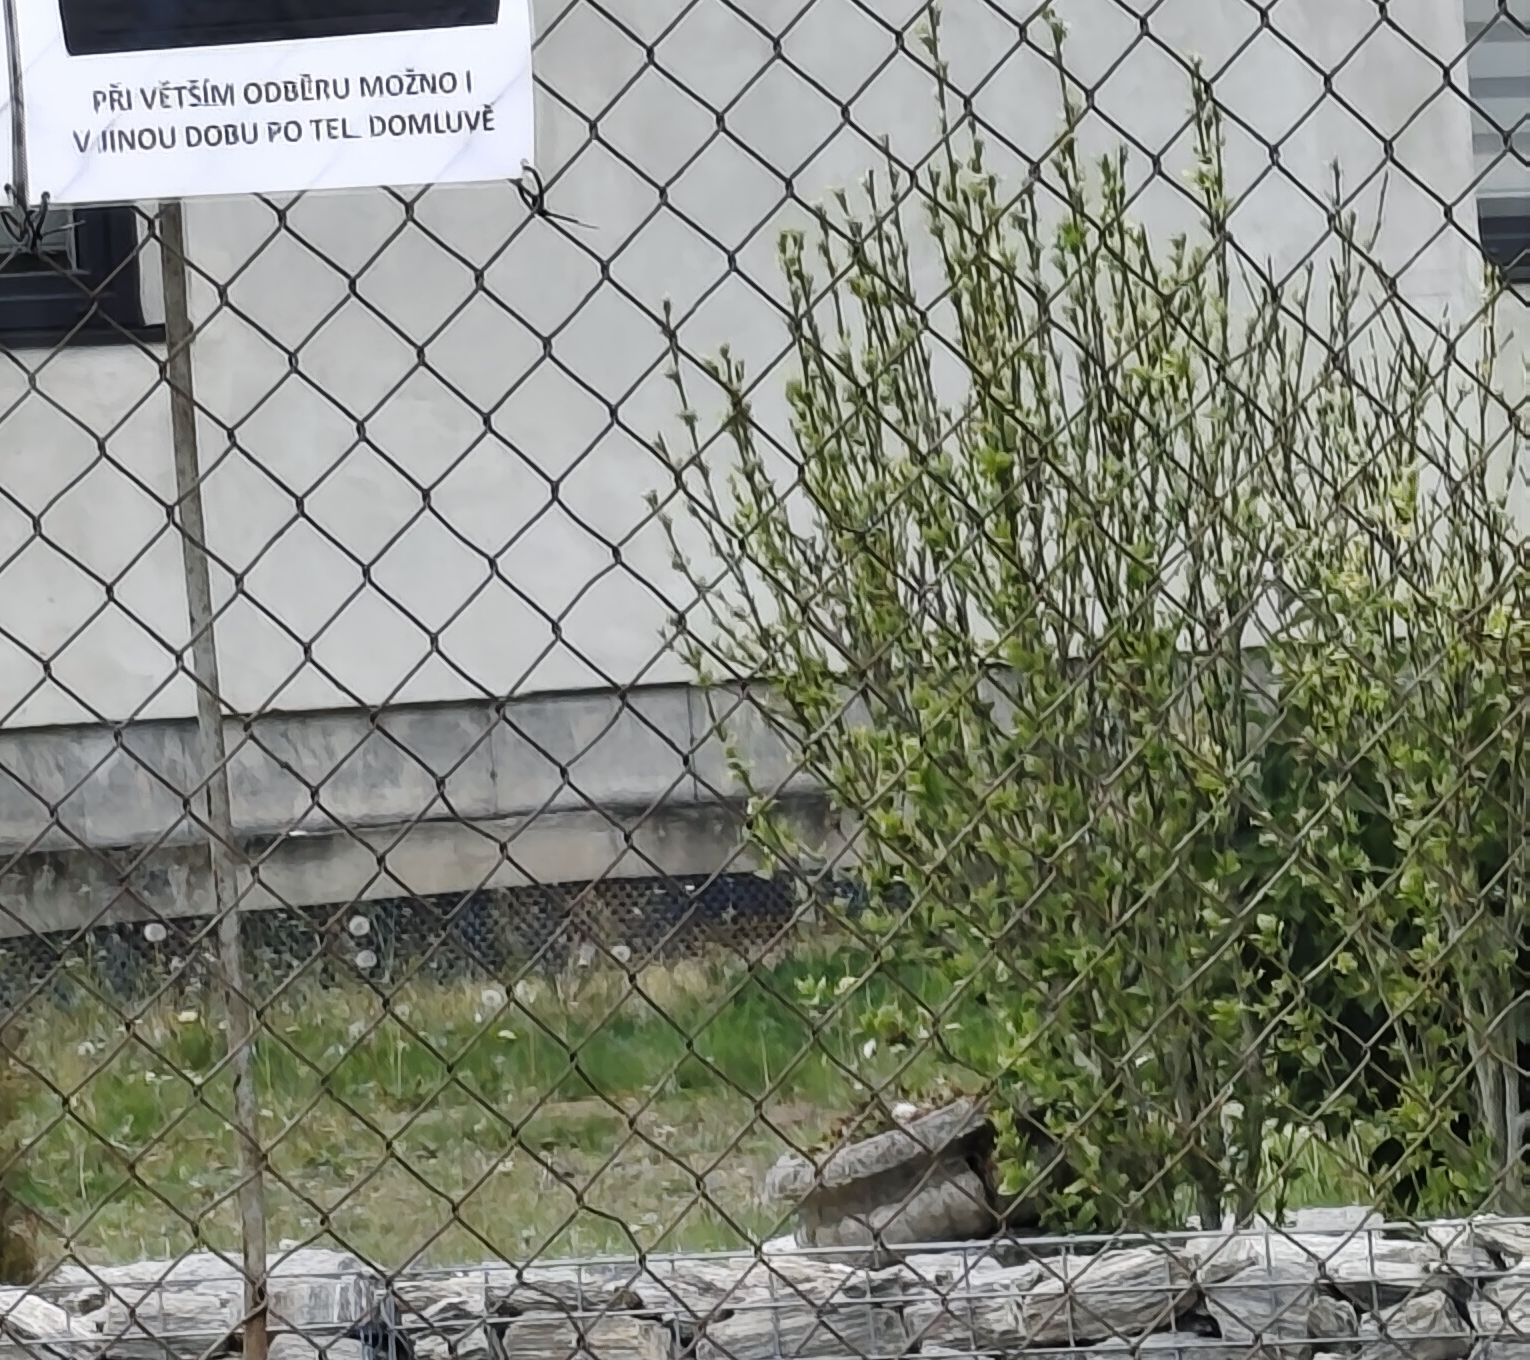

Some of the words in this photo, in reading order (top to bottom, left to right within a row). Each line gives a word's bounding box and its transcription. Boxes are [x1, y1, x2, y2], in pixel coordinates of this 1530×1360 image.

[92, 83, 132, 113] PŘI
[359, 67, 458, 98] MOŽNO
[72, 129, 90, 153] V
[185, 121, 258, 148] DOBU
[267, 120, 303, 143] PO
[369, 103, 496, 139] DOMLUVĚ
